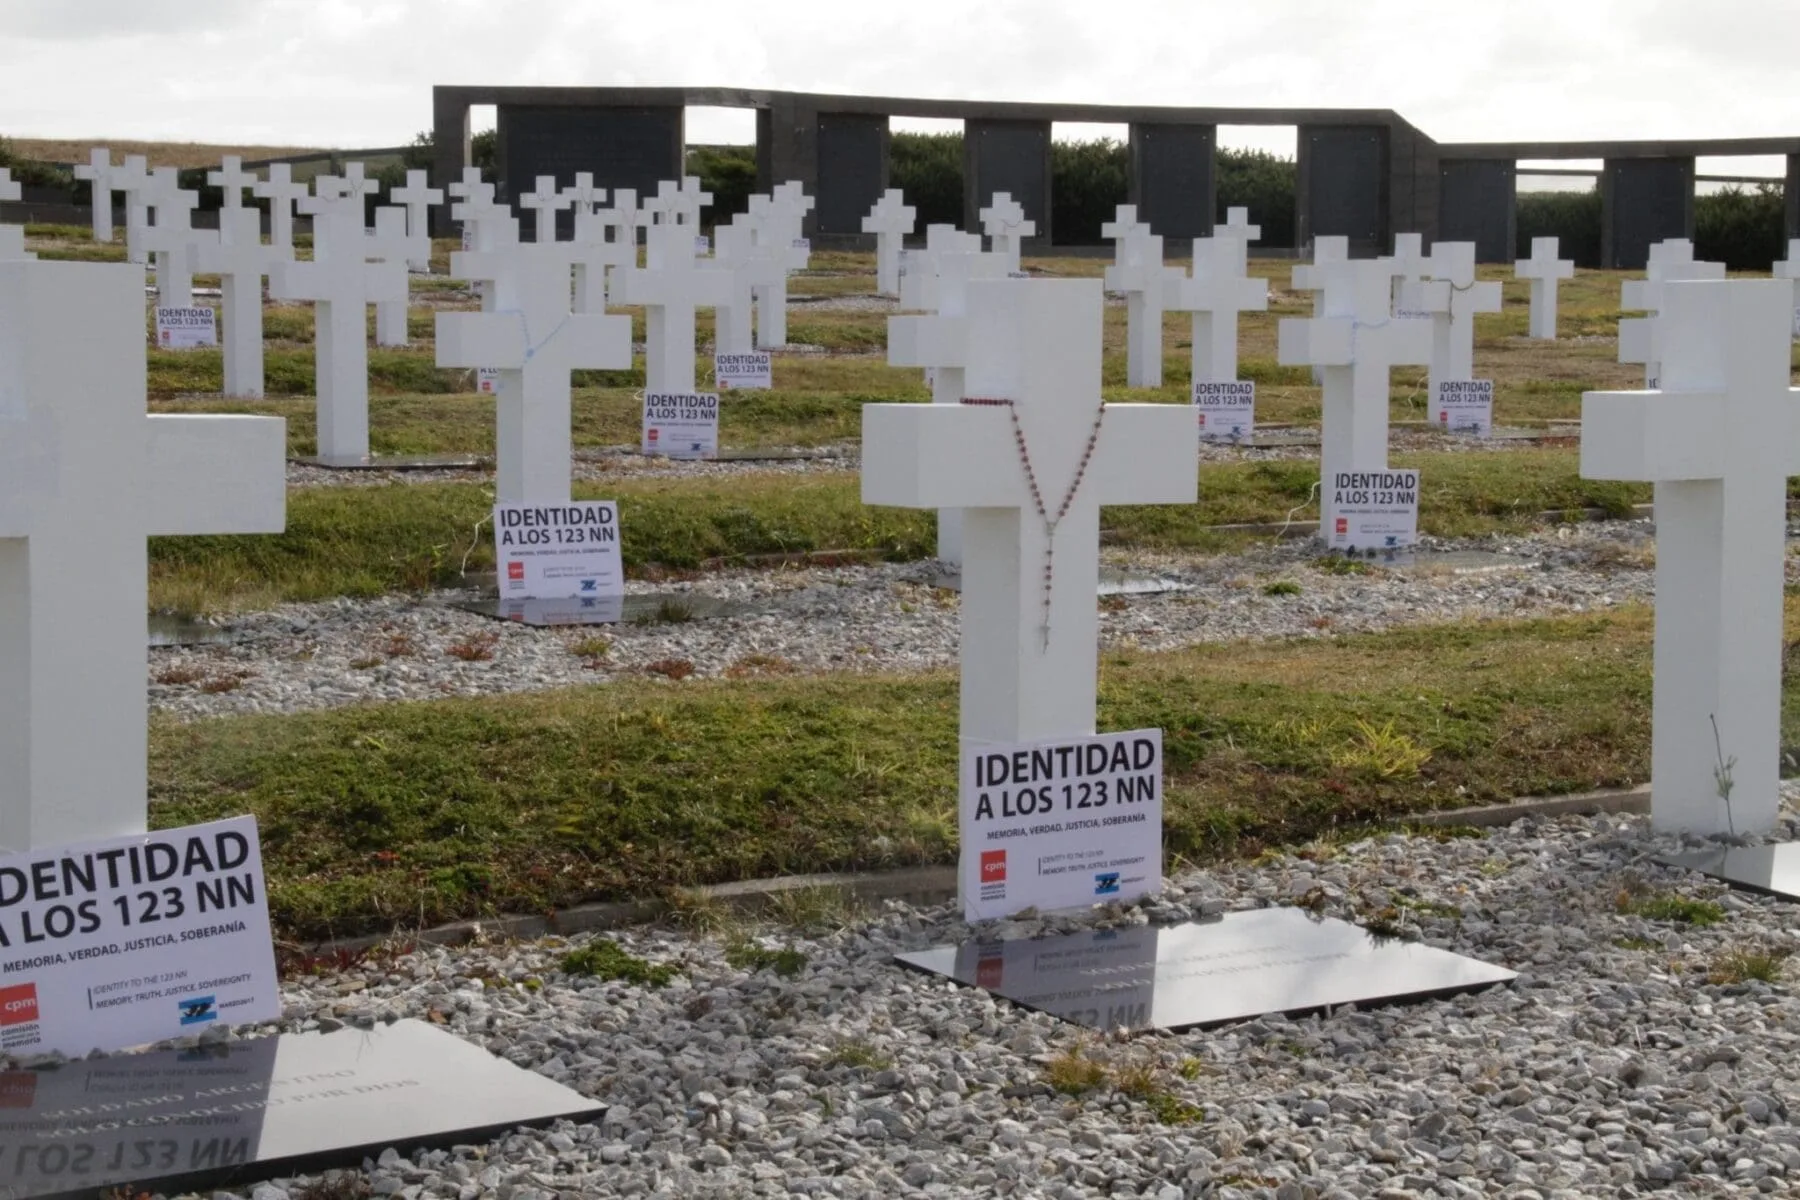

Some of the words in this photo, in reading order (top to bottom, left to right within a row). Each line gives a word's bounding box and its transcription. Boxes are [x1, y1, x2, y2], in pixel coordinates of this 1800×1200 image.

[717, 355, 768, 364] IDENTIDAD
[725, 365, 739, 373] LOS
[741, 365, 755, 373] 123
[1196, 383, 1252, 394] IDENTIDAD
[1440, 382, 1491, 392] IDENTIDAD
[647, 394, 717, 408] IDENTIDAD
[1196, 396, 1201, 404] A
[1204, 396, 1220, 404] LOS
[1222, 396, 1237, 404] 123
[1239, 396, 1252, 404] NN
[646, 408, 654, 417] A
[656, 408, 676, 419] LOS
[680, 409, 697, 419] 123
[701, 409, 716, 419] NN
[1335, 473, 1415, 489] IDENTIDAD
[1335, 491, 1343, 504] A
[1346, 491, 1368, 504] LOS
[1373, 491, 1393, 504] 123
[1396, 491, 1415, 504] NN
[500, 506, 612, 527] IDENTIDAD
[502, 530, 513, 545] A
[518, 529, 550, 544] LOS
[555, 528, 584, 543] 123
[590, 527, 614, 541] NN
[975, 739, 1155, 788] IDENTIDAD
[975, 793, 994, 821] A
[1002, 786, 1052, 818] LOS
[1062, 781, 1108, 810] 123
[1116, 775, 1155, 804] NN
[987, 828, 1028, 840] MEMORIA,
[0, 831, 249, 908] DENTIDAD
[22, 899, 101, 943] LOS
[114, 887, 185, 926] 123
[196, 873, 255, 912] NN
[3, 952, 67, 973] MEMORIA,
[68, 943, 121, 961] VERDAD,
[123, 933, 178, 952] JUSTICIA,
[180, 920, 246, 941] SOBERANÍA
[131, 978, 142, 988] TO
[5, 998, 36, 1012] cpm
